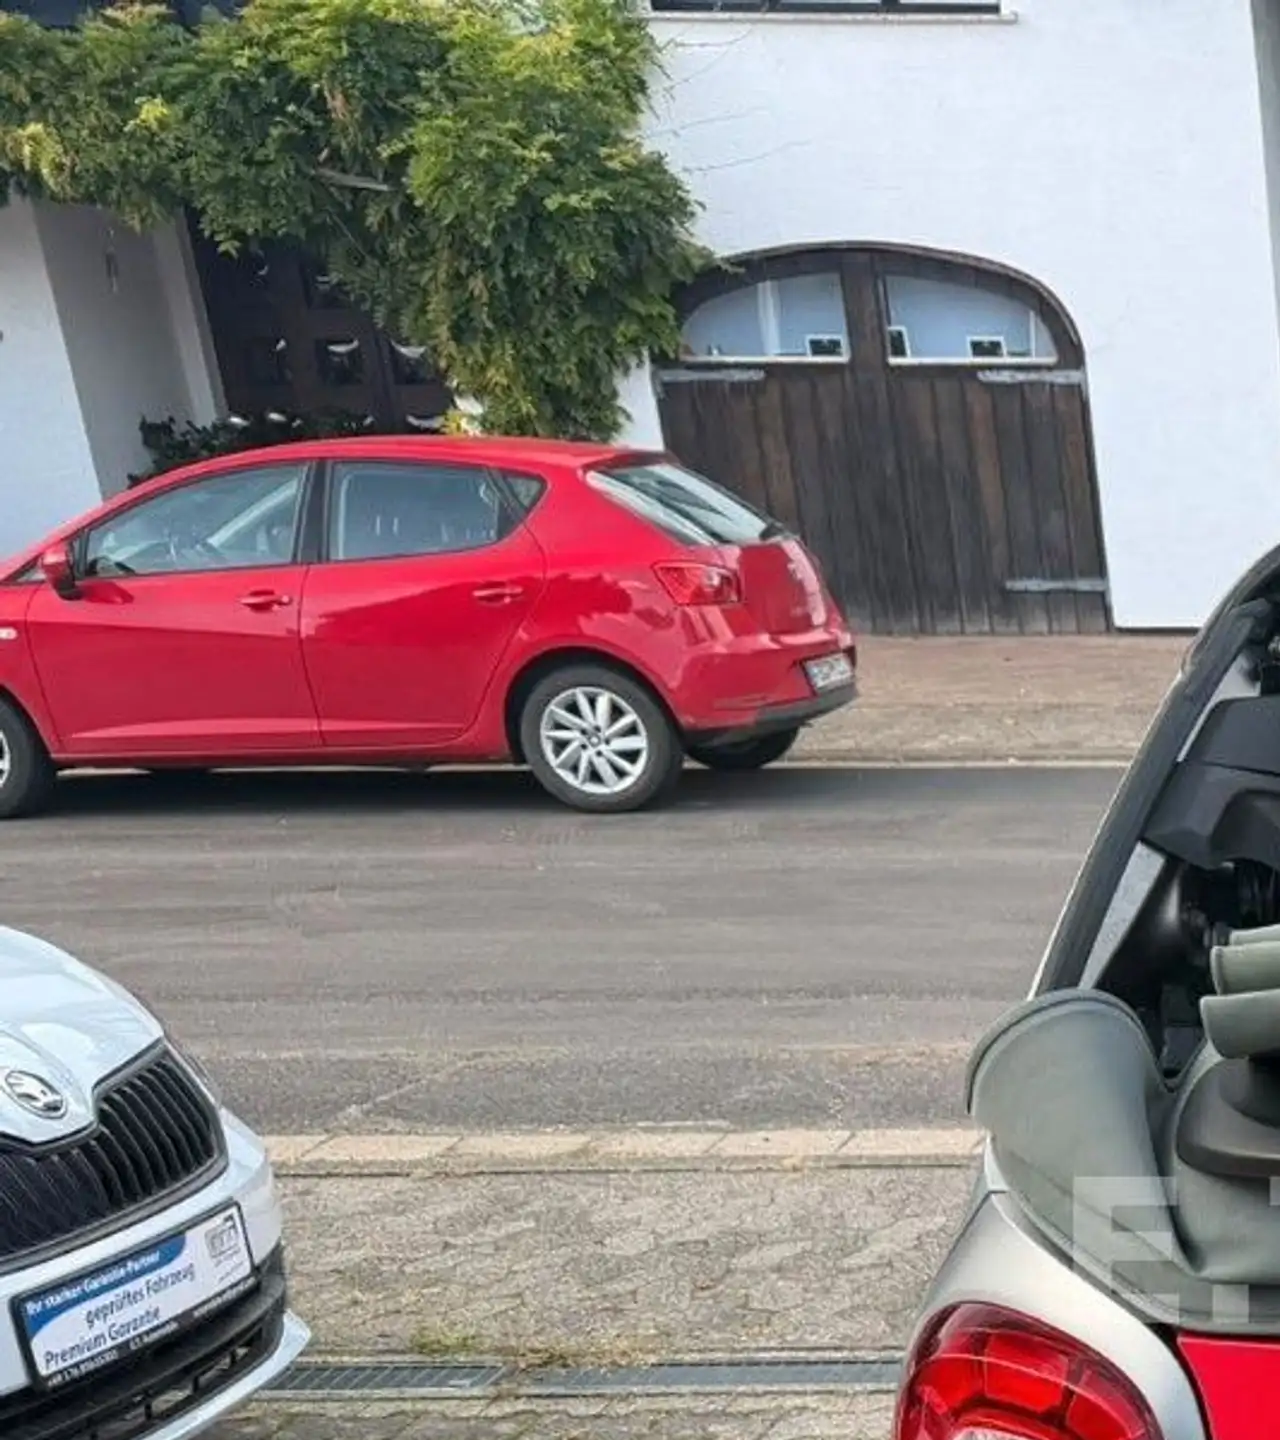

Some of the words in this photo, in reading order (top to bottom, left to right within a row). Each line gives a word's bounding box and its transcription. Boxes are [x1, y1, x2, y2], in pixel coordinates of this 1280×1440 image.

[86, 1289, 145, 1329] geprüftes
[145, 1263, 196, 1294] Fahrzeug
[44, 1334, 107, 1370] Premium
[108, 1306, 160, 1340] Garantie
